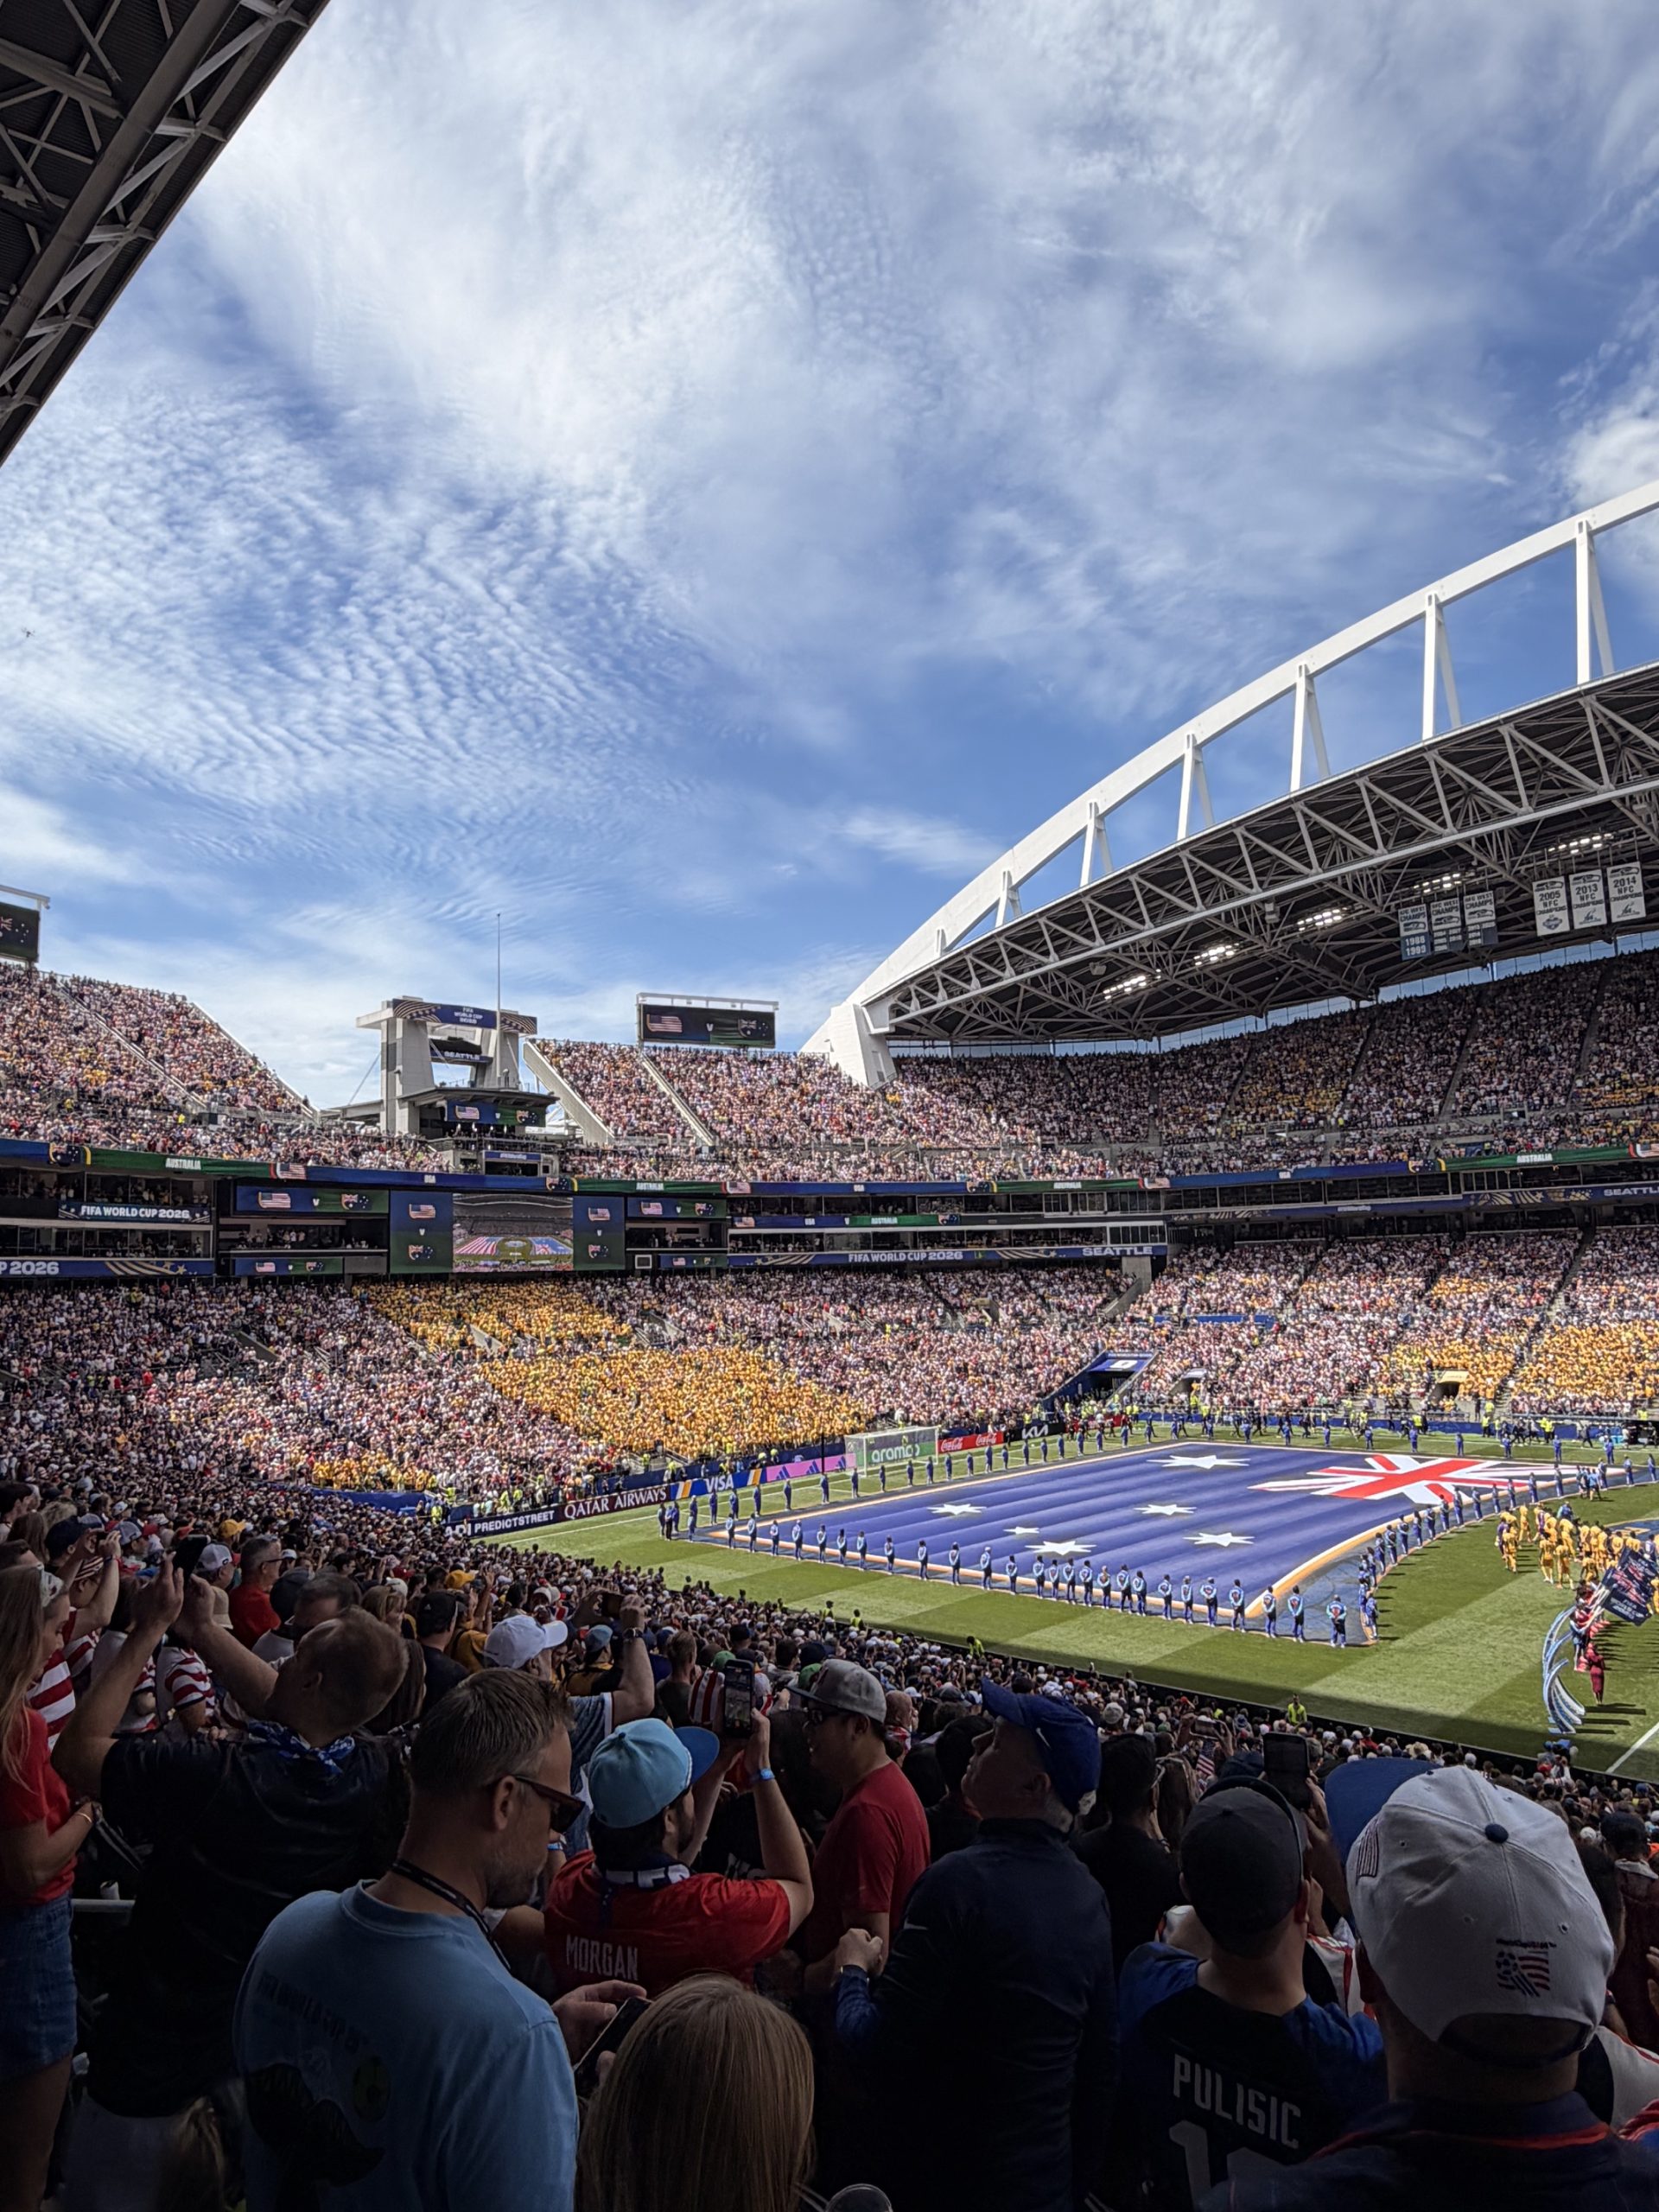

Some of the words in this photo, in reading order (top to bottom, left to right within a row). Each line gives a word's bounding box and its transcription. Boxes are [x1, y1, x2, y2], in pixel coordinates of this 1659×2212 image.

[1612, 875, 1637, 888] 2014
[1538, 890, 1560, 901] 2005
[1575, 883, 1599, 895] 2013
[165, 1157, 201, 1170] AUSTRALIA
[1516, 1154, 1553, 1163] AUSTRALIA
[80, 1205, 102, 1216] FIFA
[103, 1206, 138, 1217] WORLD
[138, 1208, 158, 1217] CUP
[158, 1209, 190, 1218] 2026
[849, 1253, 870, 1262] FIFA
[870, 1252, 906, 1262] WORLD
[907, 1251, 927, 1261] CUP
[928, 1251, 963, 1261] 2026
[1082, 1246, 1153, 1257] SEATTLE
[9, 1262, 60, 1275] 2026
[705, 1473, 734, 1493] VISA
[564, 1497, 610, 1520] QATAR
[613, 1486, 667, 1510] AIRWAYS
[474, 1510, 556, 1534] PREDICTSTREET
[566, 1933, 639, 1981] MORGAN
[1173, 2053, 1302, 2150] PULISIC
